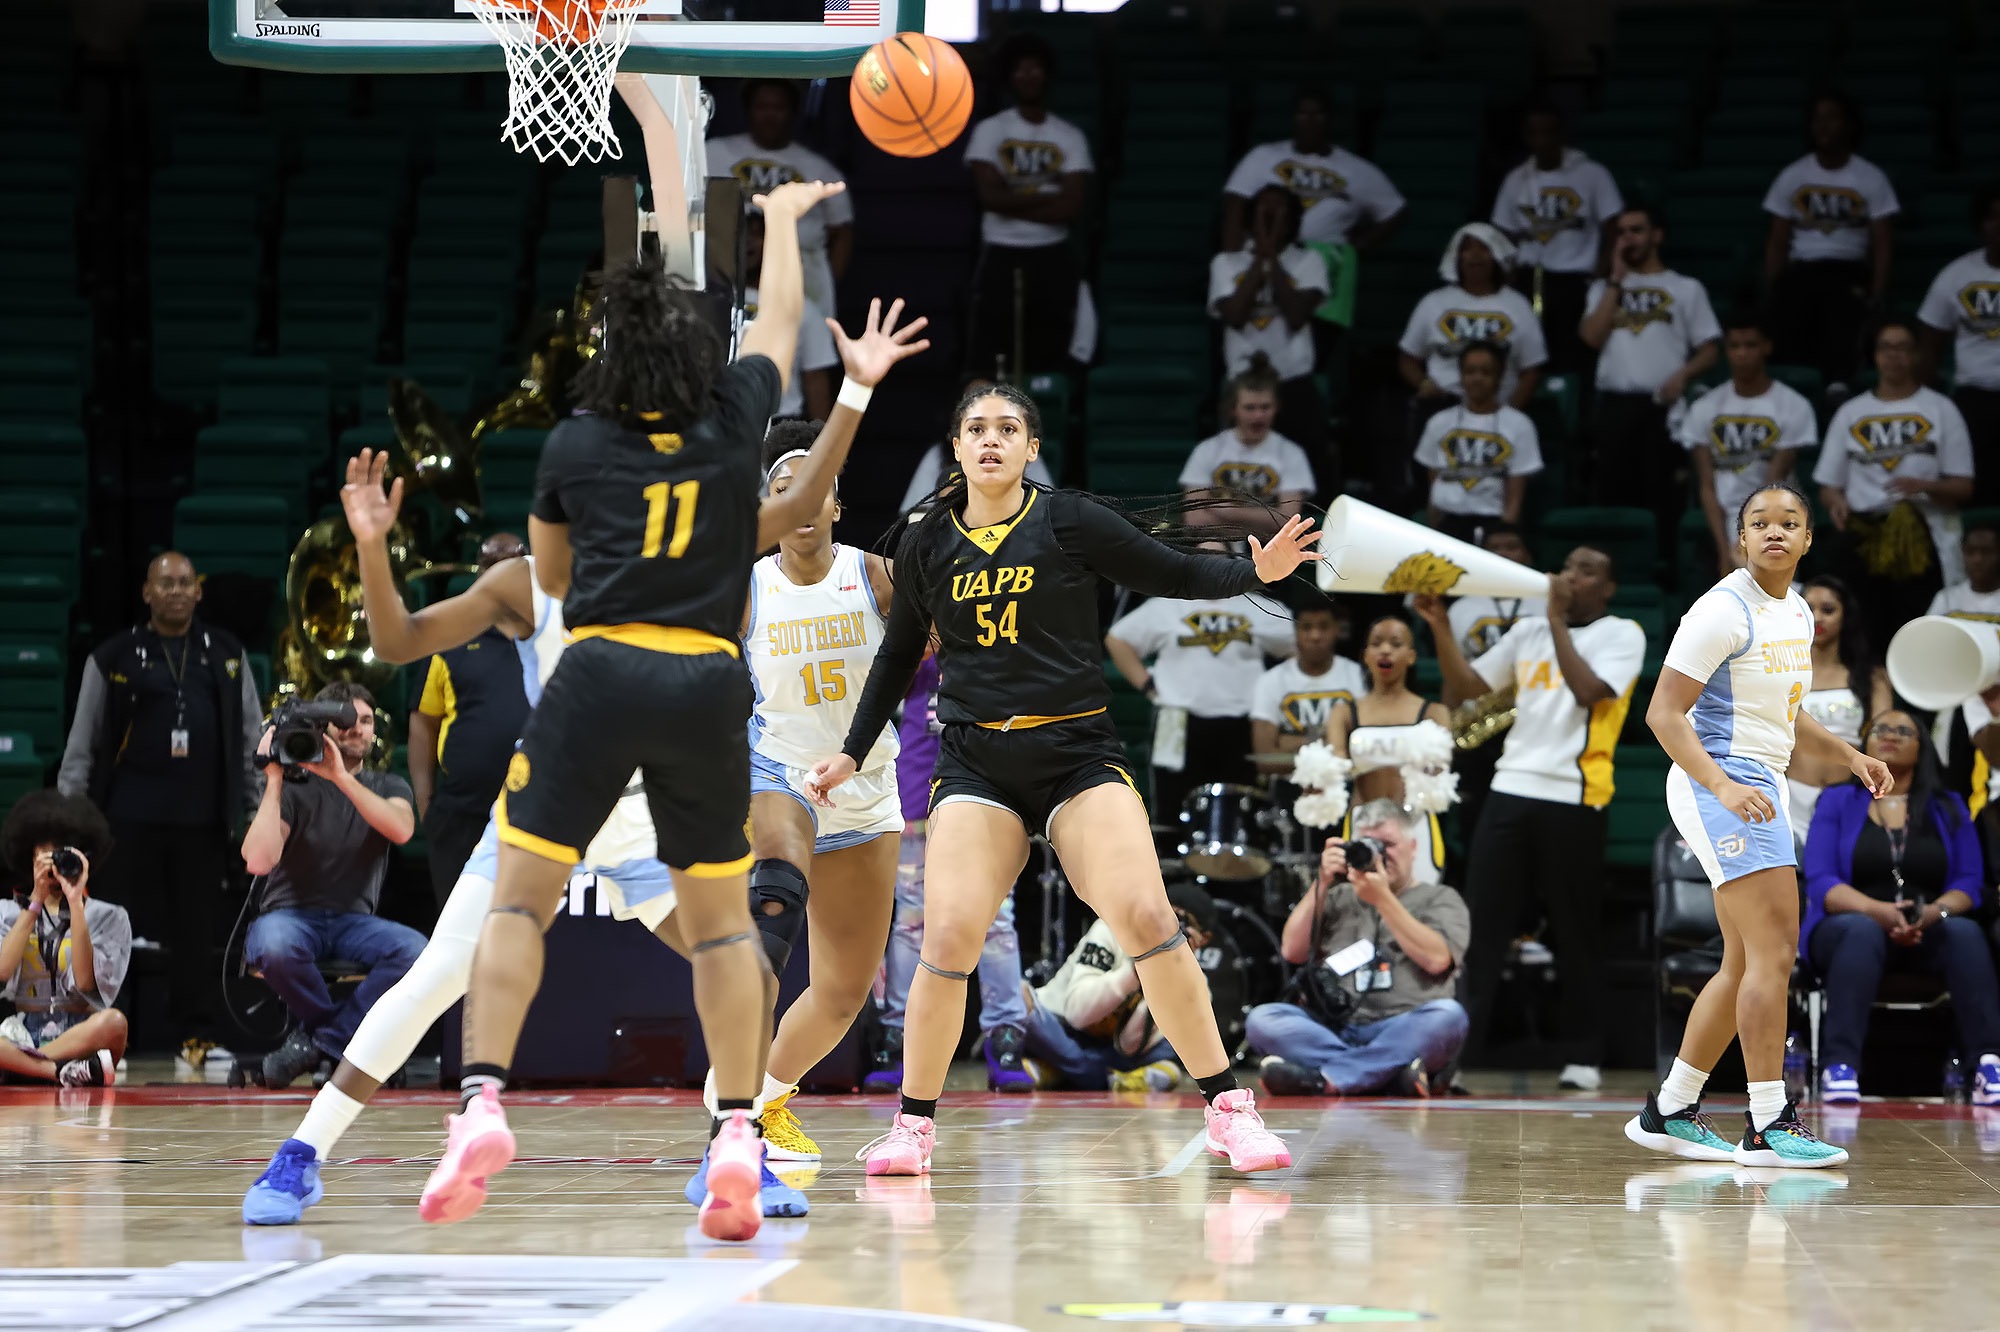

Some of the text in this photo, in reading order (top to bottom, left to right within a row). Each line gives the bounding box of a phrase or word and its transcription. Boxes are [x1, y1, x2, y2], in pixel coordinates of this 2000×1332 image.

[256, 23, 320, 37] SPALDING
[641, 480, 700, 558] 11
[952, 566, 1035, 601] UAPB
[768, 611, 867, 656] SOUTHERN
[976, 601, 1018, 646] 54
[799, 659, 846, 707] 15
